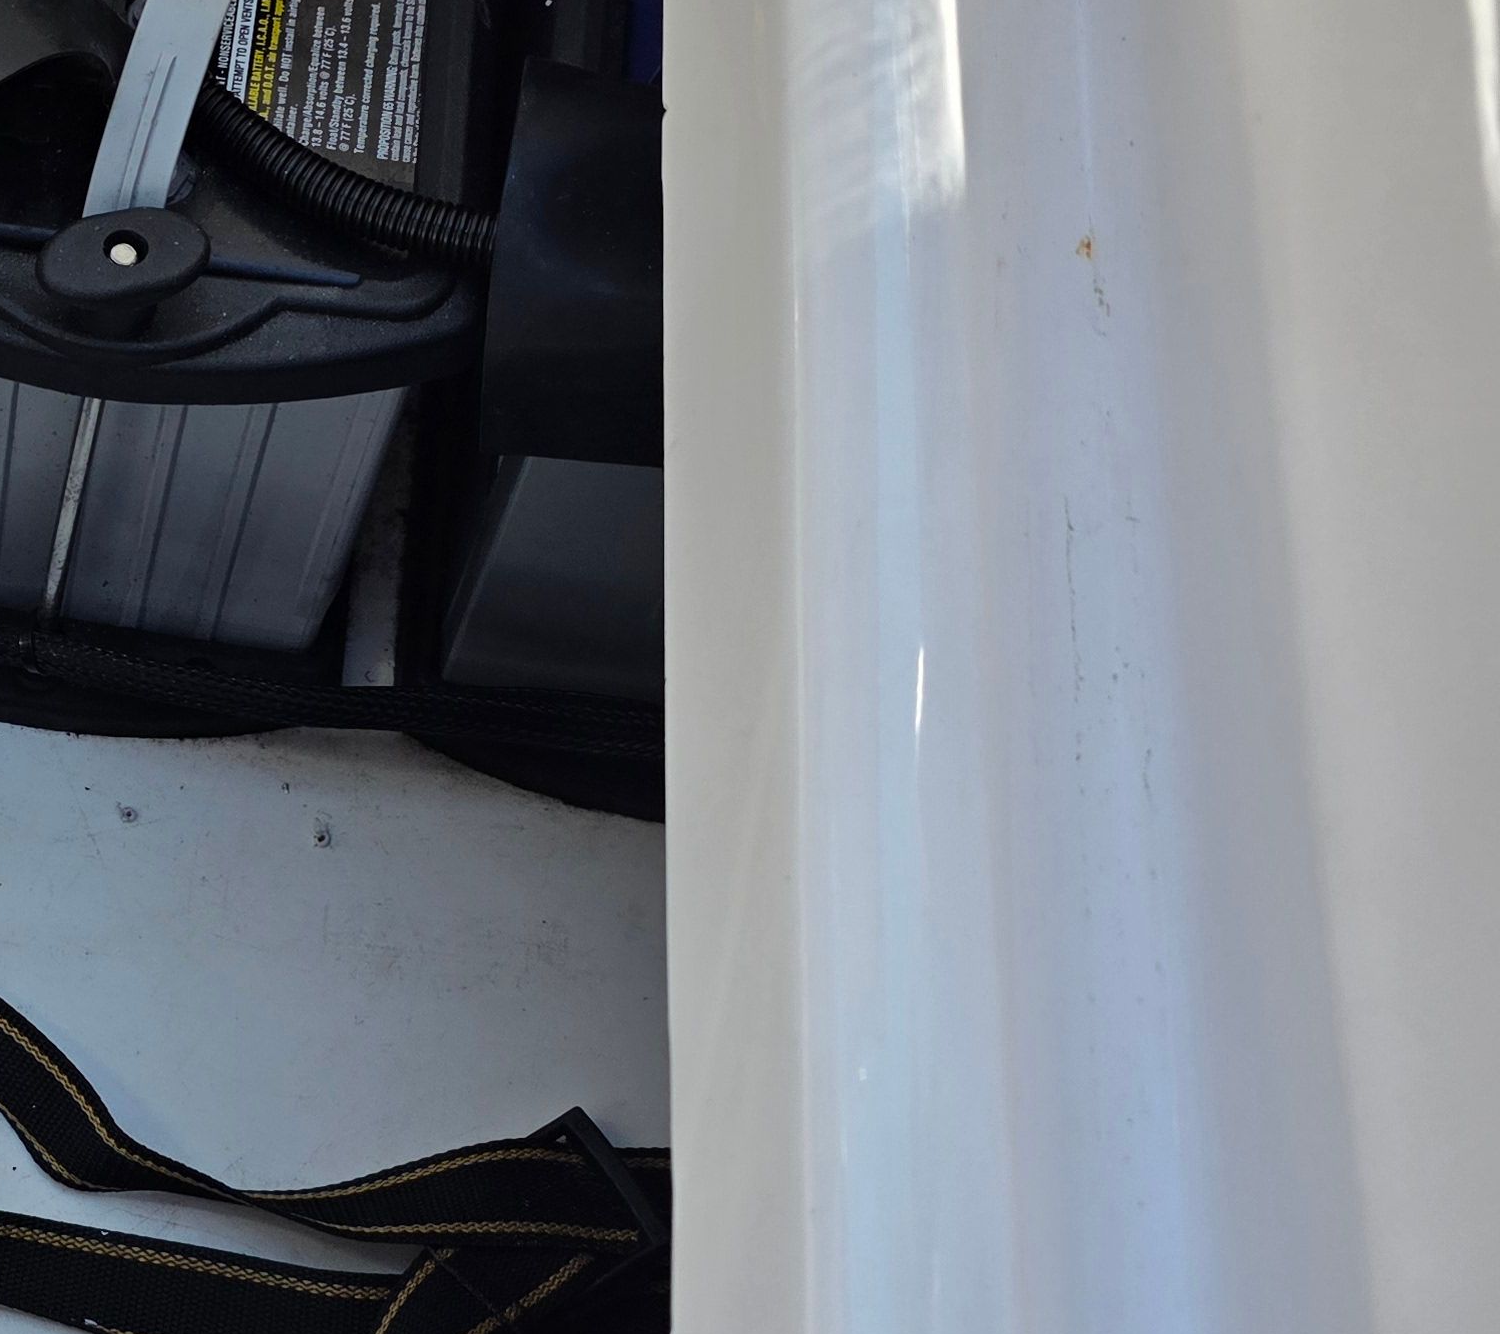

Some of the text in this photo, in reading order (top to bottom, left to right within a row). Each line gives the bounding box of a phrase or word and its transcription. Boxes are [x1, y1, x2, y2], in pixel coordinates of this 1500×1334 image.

[237, 24, 250, 45] OPEN
[236, 46, 247, 57] TO
[280, 52, 292, 69] NOT
[364, 35, 380, 68] charging
[230, 58, 246, 96] ATTEMPT
[278, 69, 290, 82] Do
[359, 68, 374, 103] corrected
[325, 94, 344, 149] Float/Standby
[353, 104, 371, 154] Temperature
